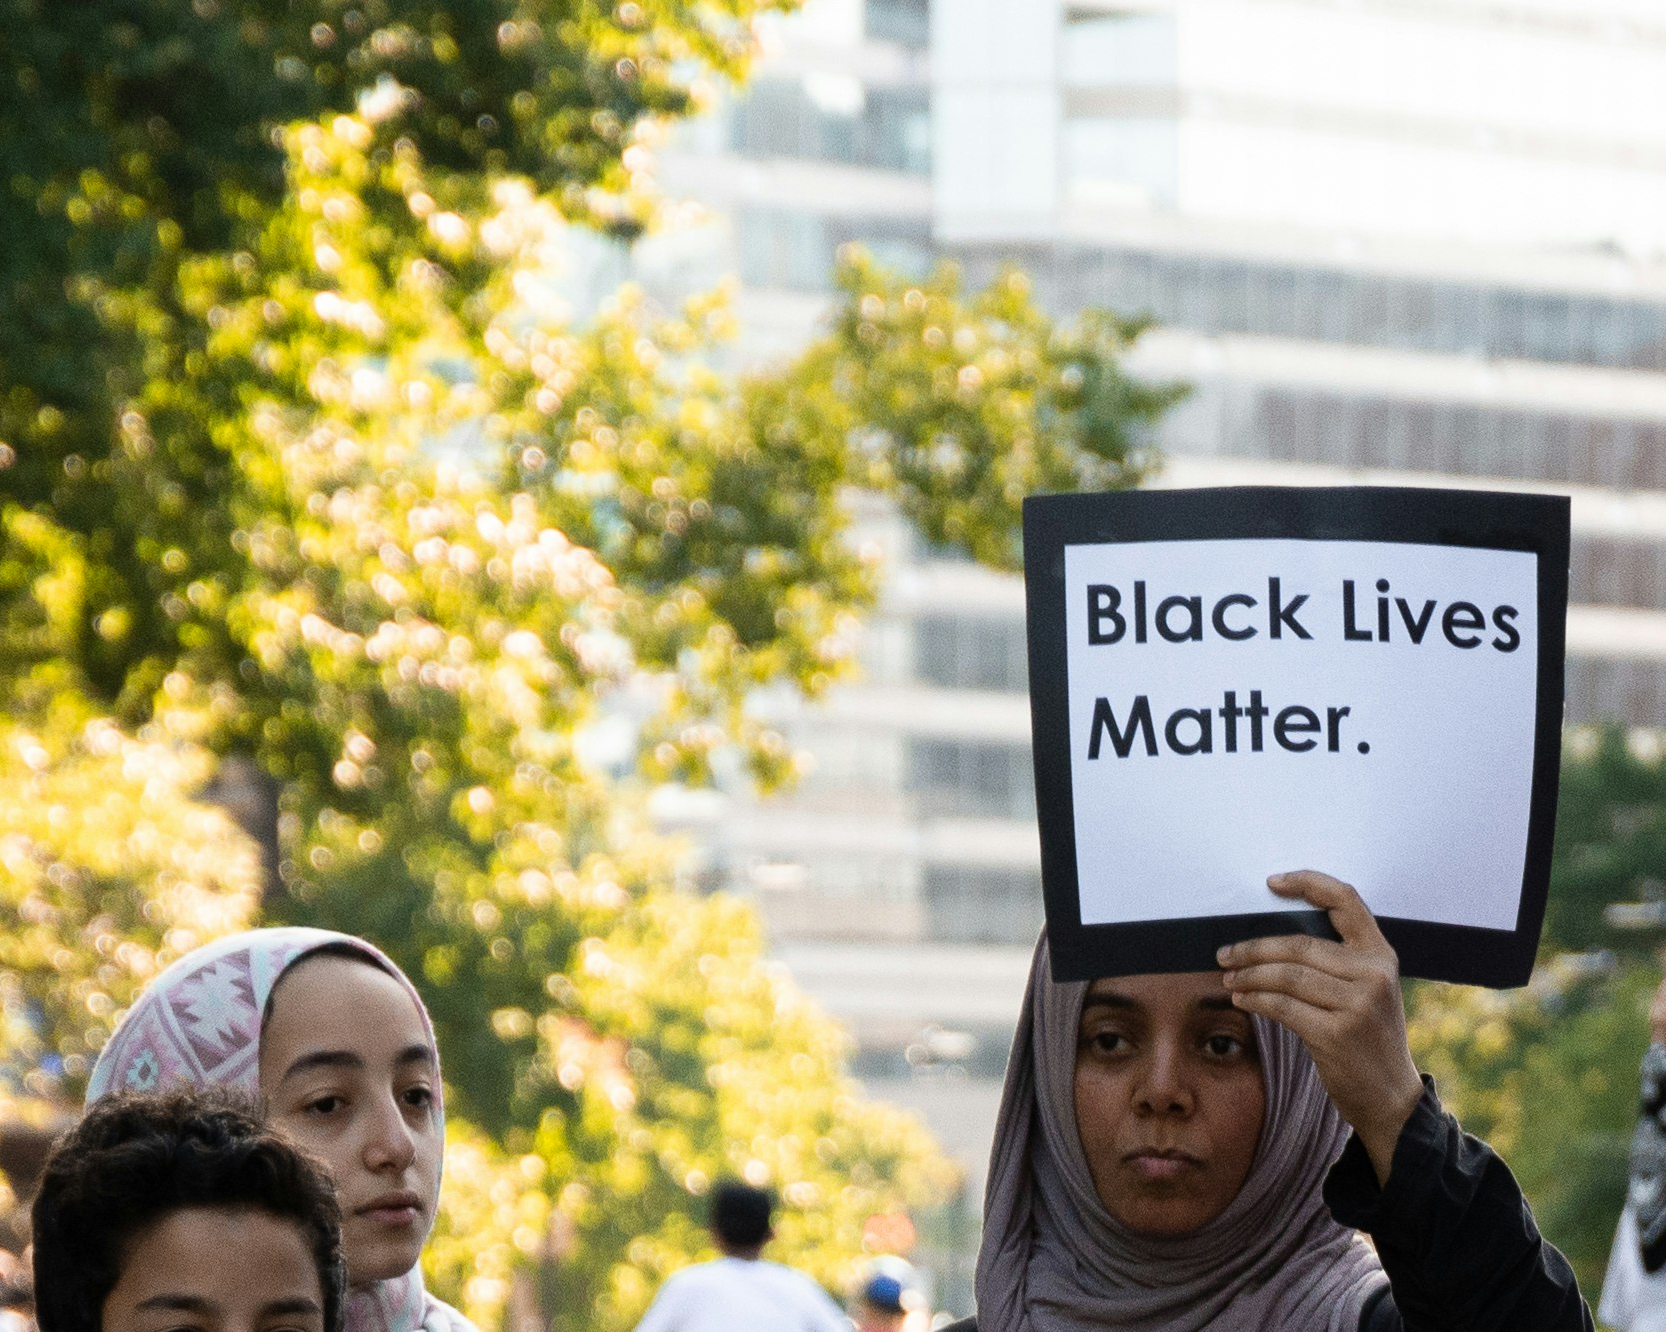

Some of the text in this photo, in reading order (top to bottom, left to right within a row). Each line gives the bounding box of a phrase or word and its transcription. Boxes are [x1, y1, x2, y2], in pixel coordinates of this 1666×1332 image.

[1088, 578, 1519, 652] Black Lives
[1089, 691, 1369, 759] Matter.
